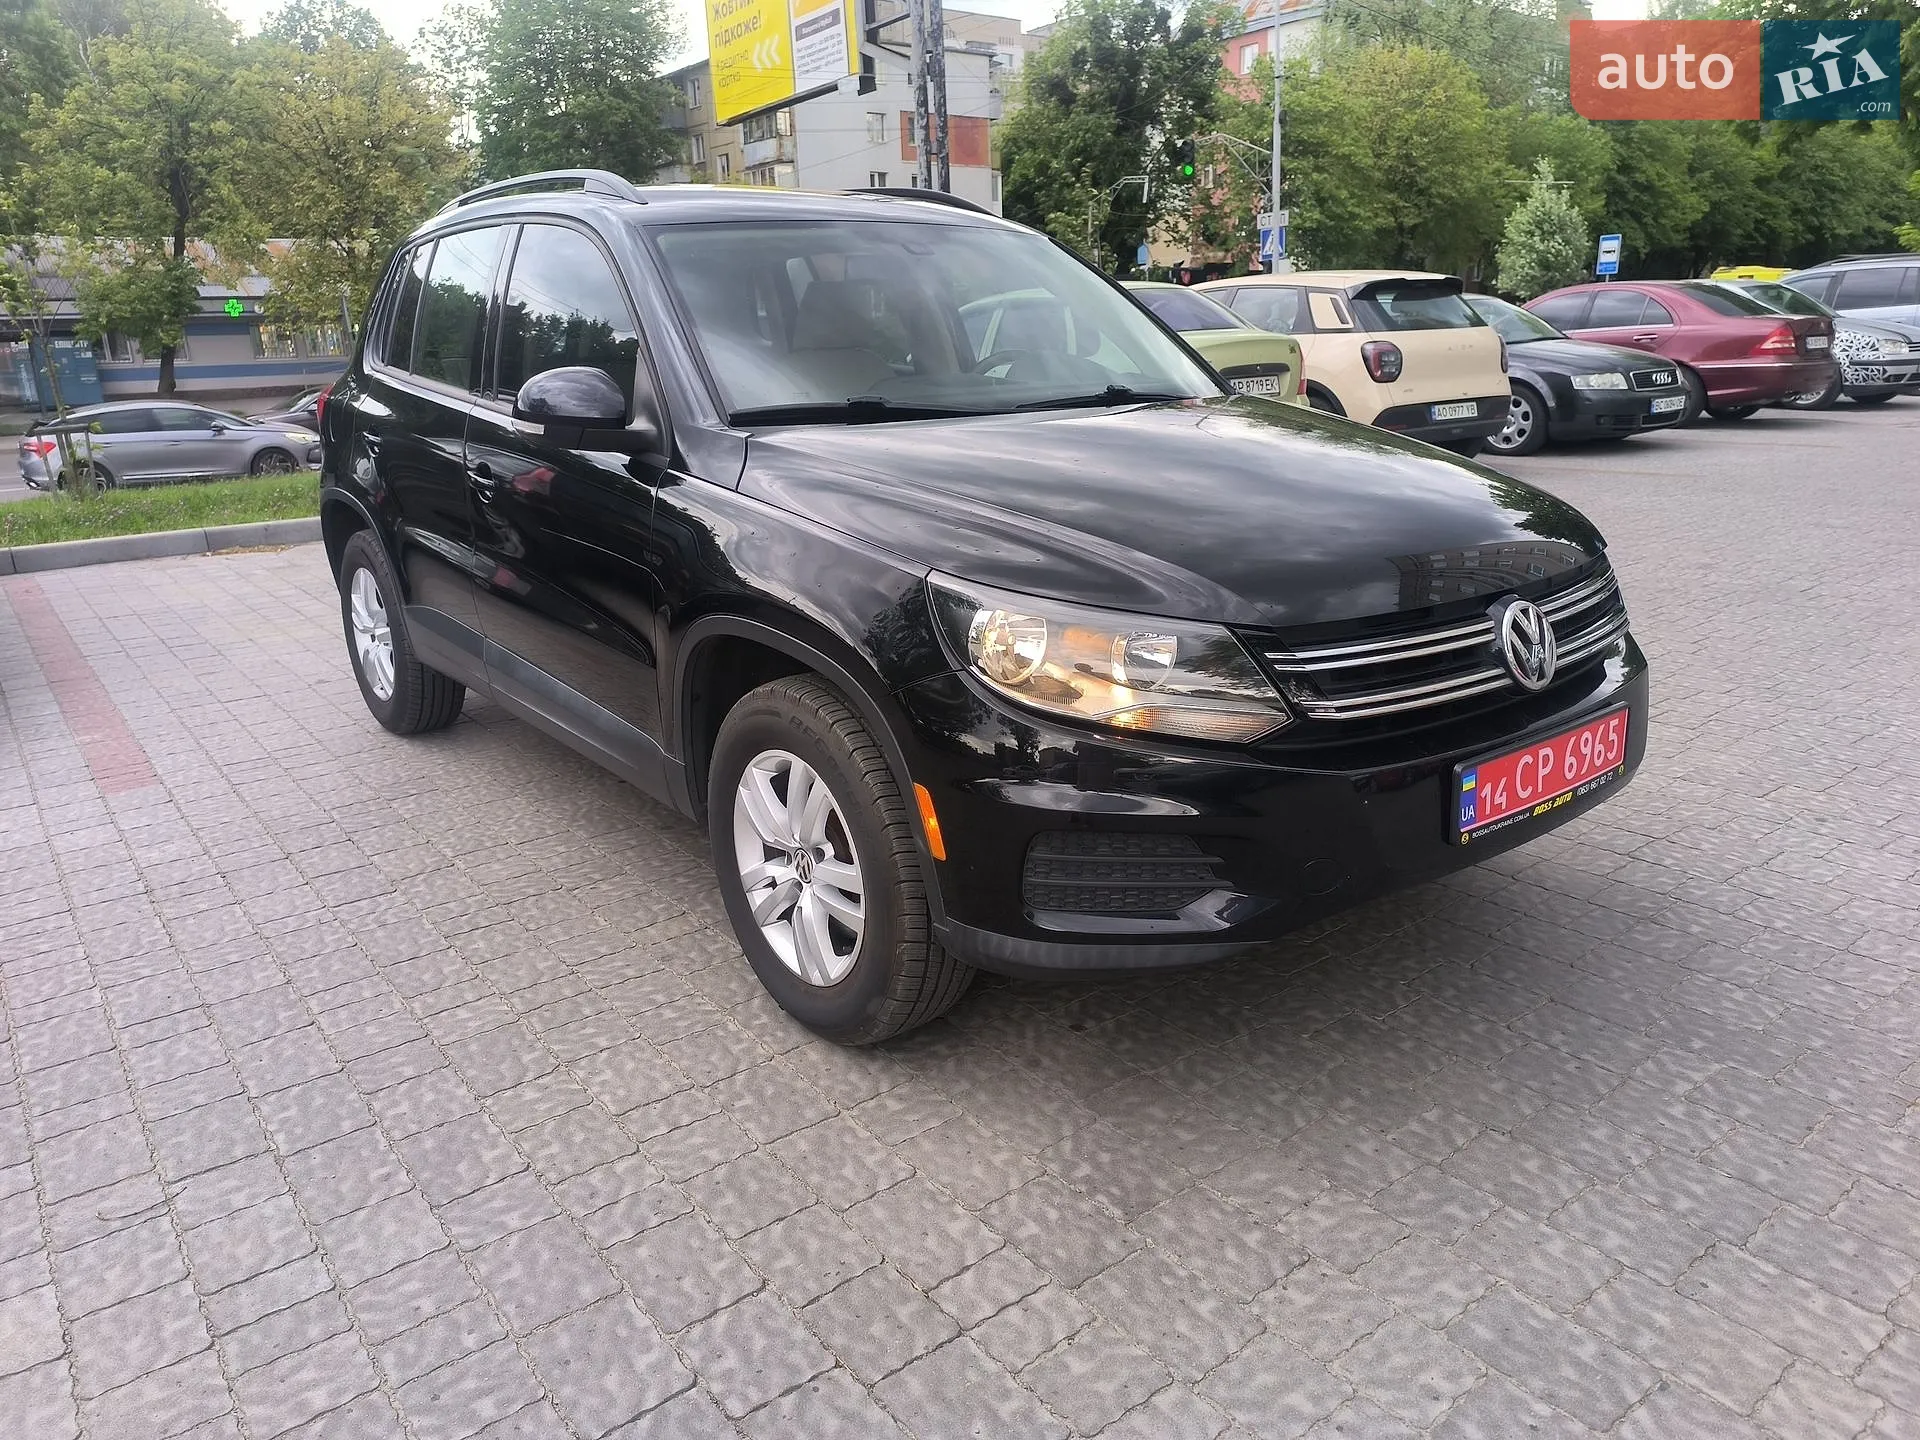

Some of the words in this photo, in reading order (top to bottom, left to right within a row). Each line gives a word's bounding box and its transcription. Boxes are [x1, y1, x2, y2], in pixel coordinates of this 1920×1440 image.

[712, 0, 754, 22] Жовти
[714, 9, 762, 48] підкаже!
[1260, 213, 1286, 227] СТП
[1246, 379, 1264, 393] 8719
[1449, 405, 1465, 417] 0977
[1480, 776, 1507, 815] 14
[1515, 746, 1555, 799] CP
[1564, 718, 1619, 780] 6965
[1461, 805, 1476, 822] UA
[1532, 800, 1553, 817] BOSS
